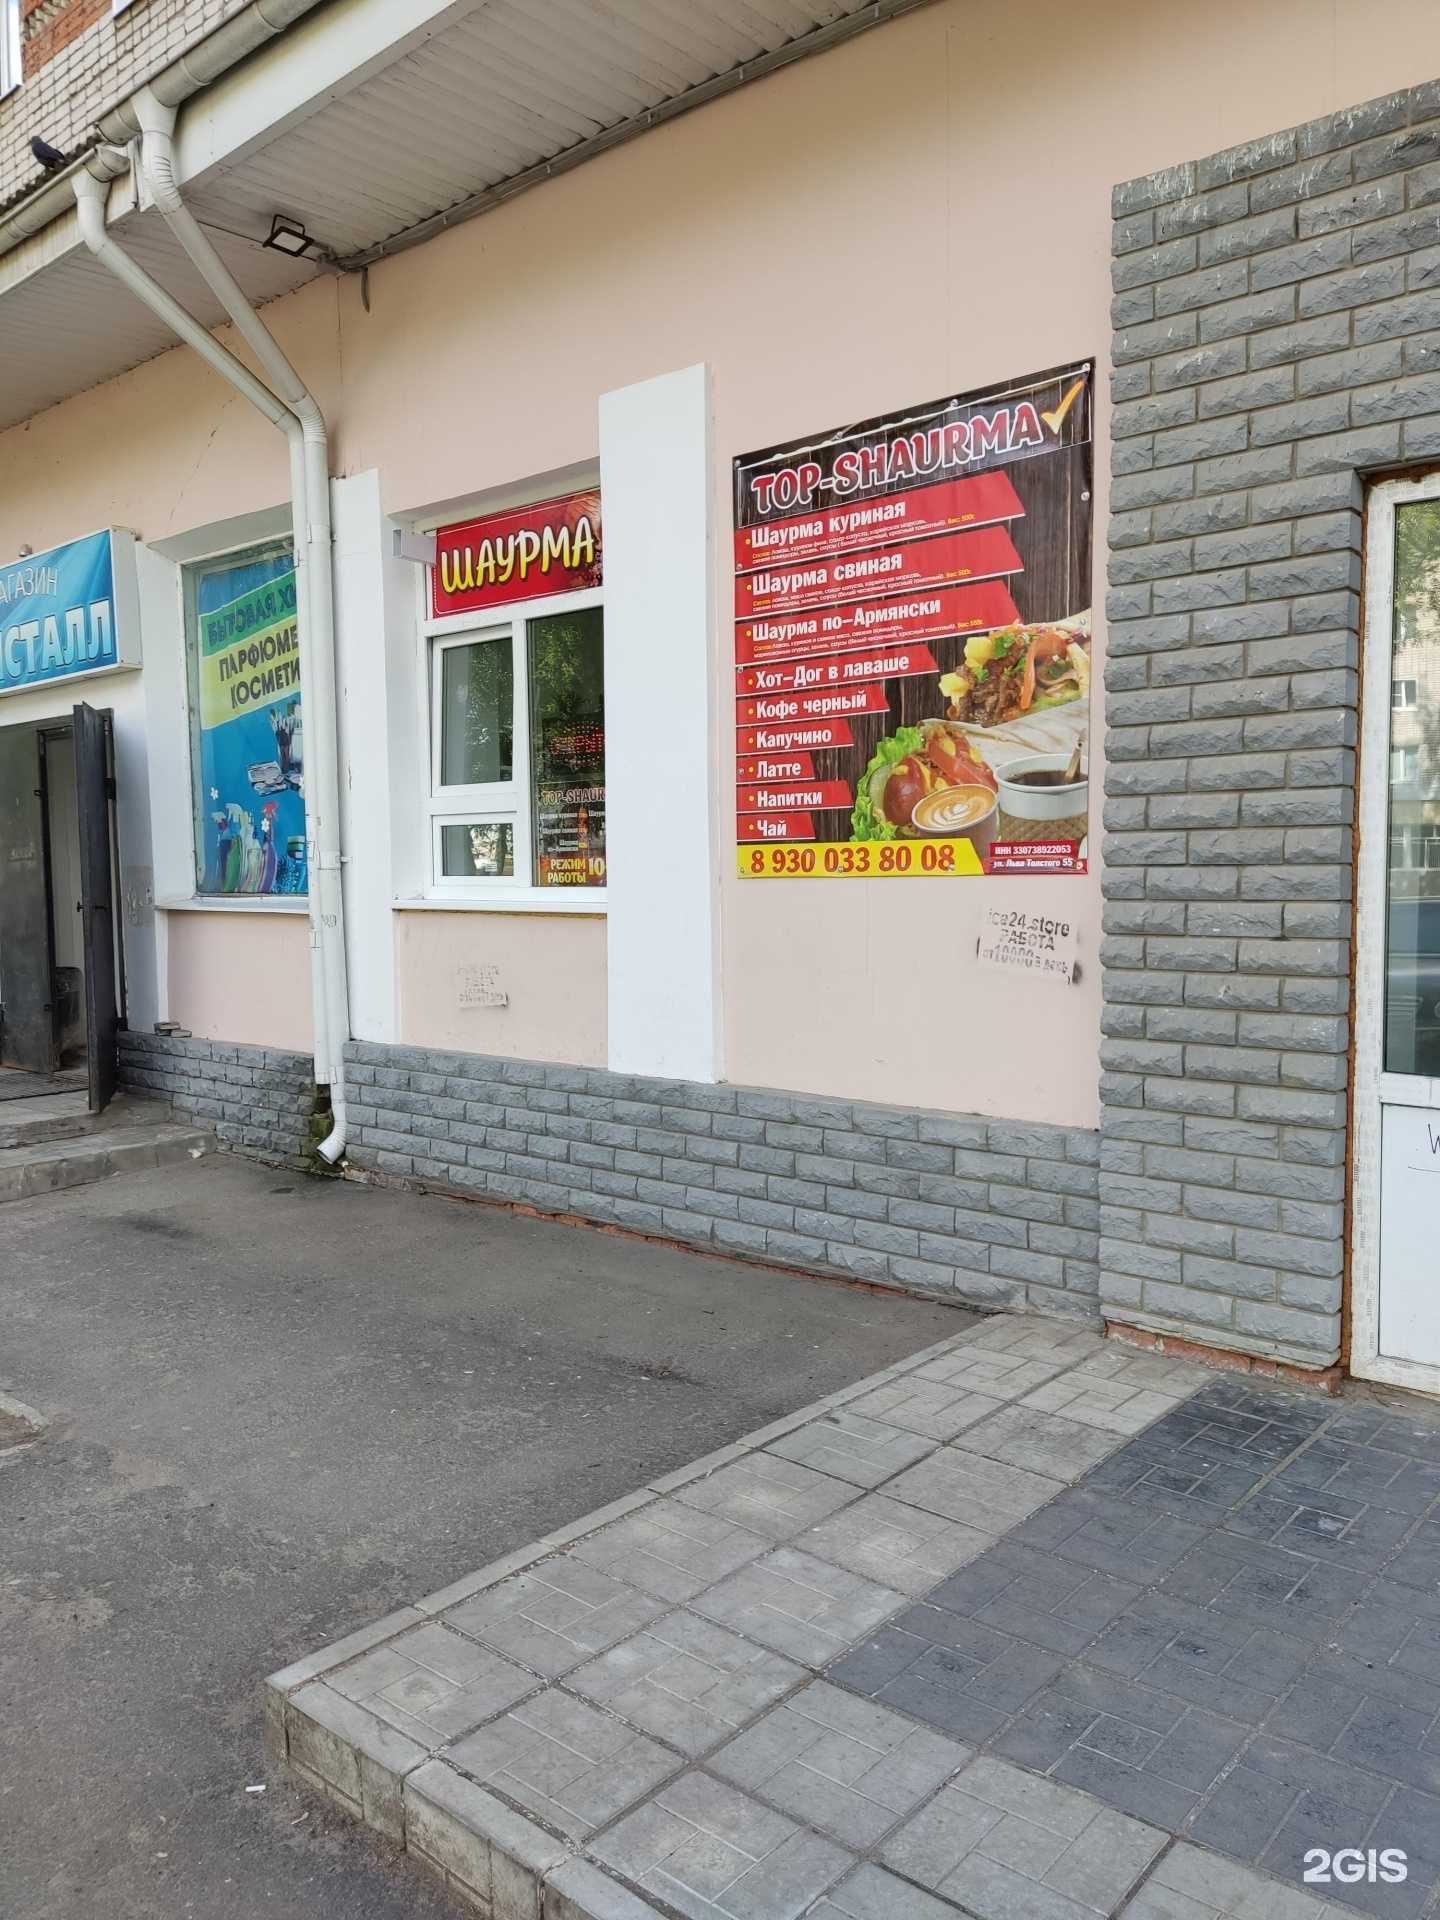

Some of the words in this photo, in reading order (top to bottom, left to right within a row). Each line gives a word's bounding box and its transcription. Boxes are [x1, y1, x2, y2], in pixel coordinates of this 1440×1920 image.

[751, 402, 1044, 514] TOP-SHAURMA
[752, 521, 824, 548] Шаурма
[829, 501, 906, 533] куриная
[441, 515, 595, 593] ШАУРМА
[752, 569, 828, 595] Шаурма
[833, 554, 903, 581] свиная
[207, 592, 276, 647] БЫТОВАЯ
[752, 620, 818, 642] Шаурма
[822, 600, 941, 630] по-Армянски
[0, 598, 113, 680] СТАЛЛ
[219, 624, 299, 682] ПАРФЮМЕ
[230, 657, 301, 709] КОСМЕТИ
[756, 665, 824, 689] Хот-Дог
[828, 666, 839, 680] в
[843, 656, 910, 678] лаваше
[756, 700, 799, 719] Кофе
[803, 690, 867, 715] черный
[756, 728, 832, 750] Капучино
[757, 761, 802, 778] Латте
[757, 791, 823, 808] Напитки
[757, 819, 787, 837] Чай
[551, 858, 586, 870] РЕЖИМ
[751, 849, 765, 873] 8
[772, 848, 816, 873] 930
[824, 847, 870, 873] 033
[879, 845, 912, 872] 80
[921, 844, 955, 872] 08
[547, 871, 586, 884] РАБОТЫ
